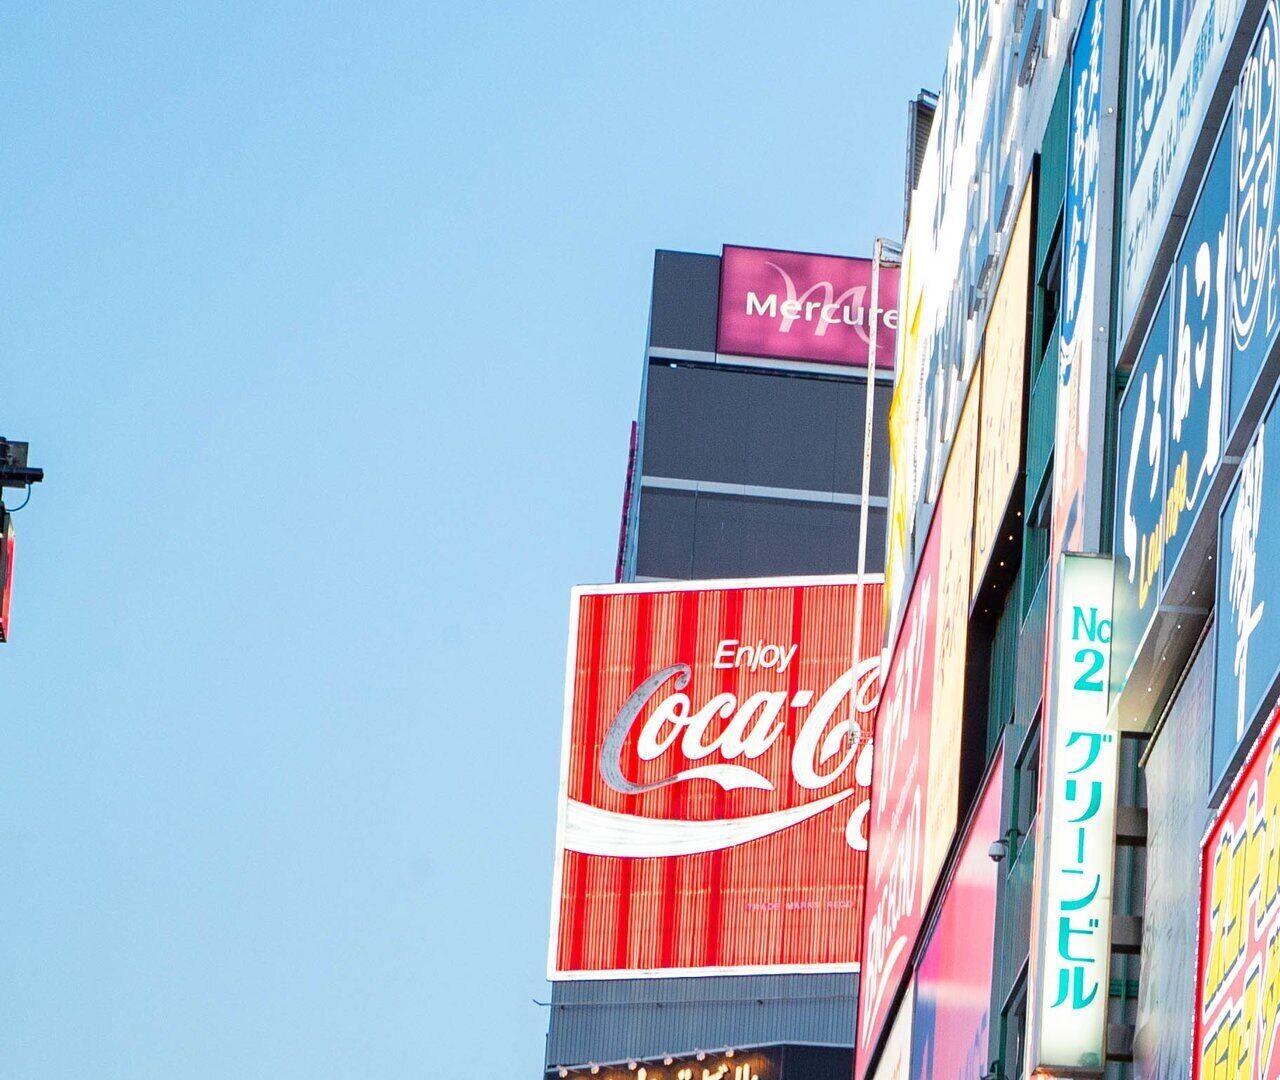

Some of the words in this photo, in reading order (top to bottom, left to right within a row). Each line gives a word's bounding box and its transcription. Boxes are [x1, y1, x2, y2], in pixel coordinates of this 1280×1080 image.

[746, 292, 898, 329] Mercure
[714, 638, 798, 673] Enjoy
[1073, 650, 1103, 692] 2
[1050, 730, 1113, 1009] グリーンビル
